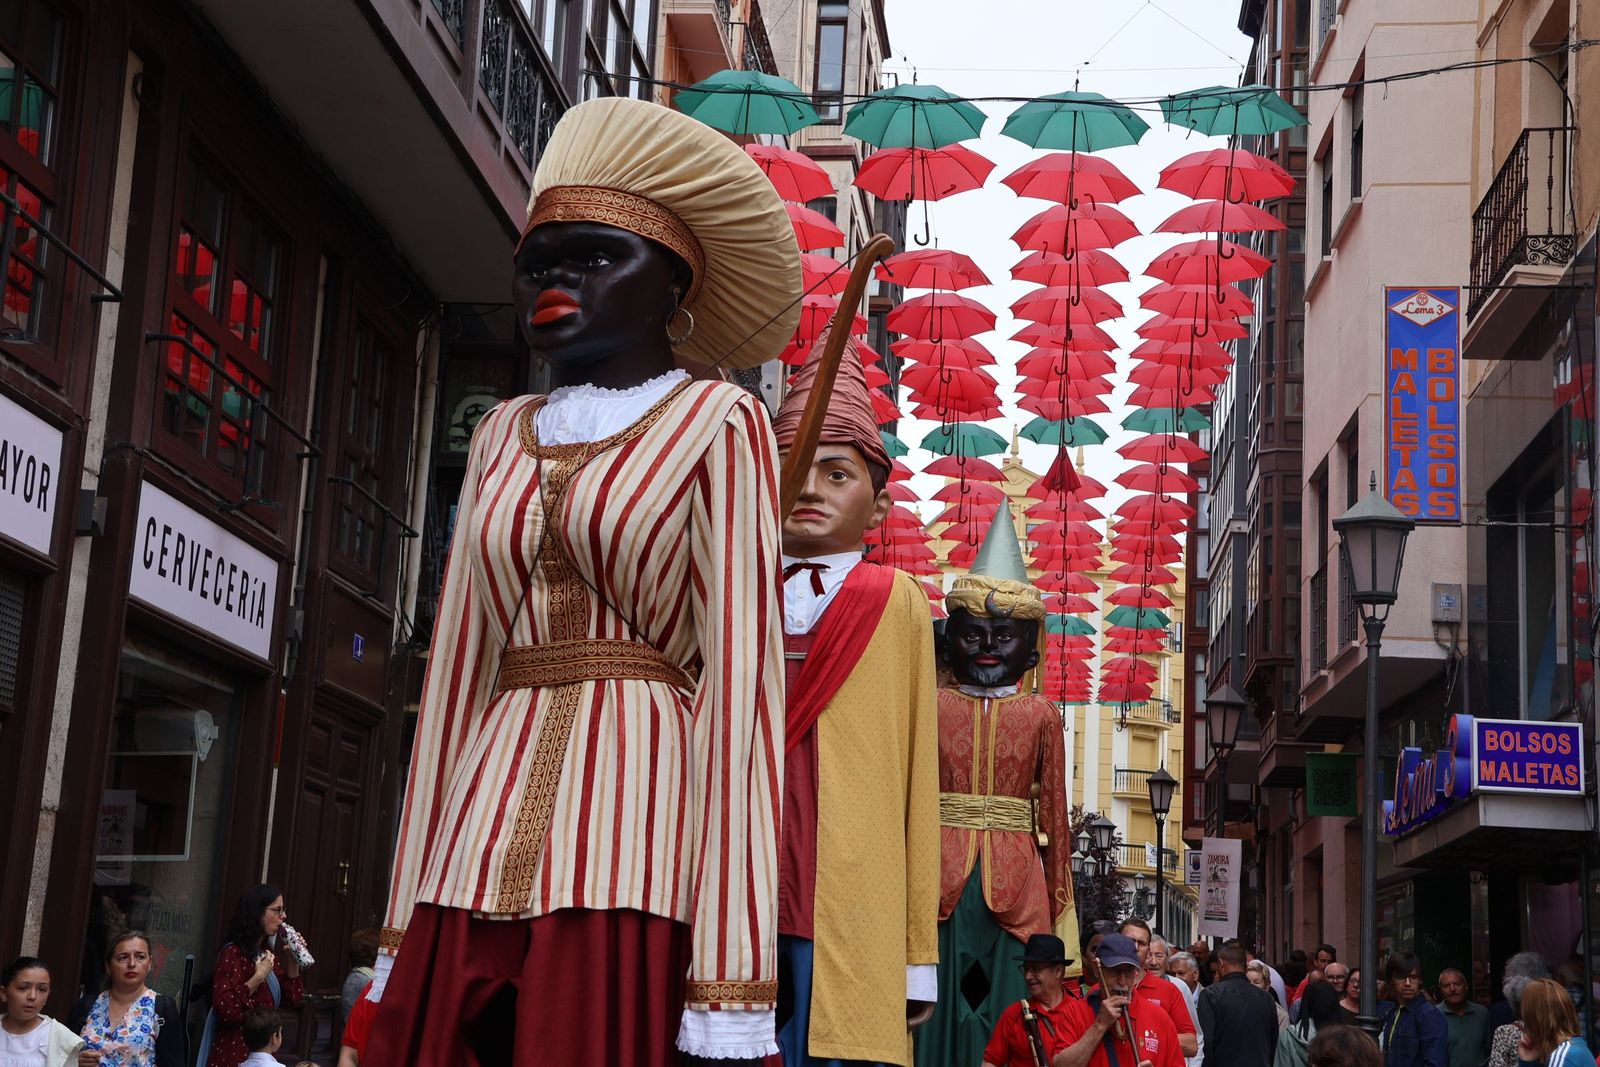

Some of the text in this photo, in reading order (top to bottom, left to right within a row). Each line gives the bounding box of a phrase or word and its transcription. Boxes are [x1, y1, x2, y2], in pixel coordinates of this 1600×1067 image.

[1401, 302, 1444, 315] Lema 3
[1391, 348, 1420, 516] MALETAS
[1427, 348, 1456, 516] BOLSOS
[1485, 729, 1572, 755] BOLSOS
[1479, 760, 1579, 786] MALETAS
[1208, 854, 1230, 865] ZAMORA
